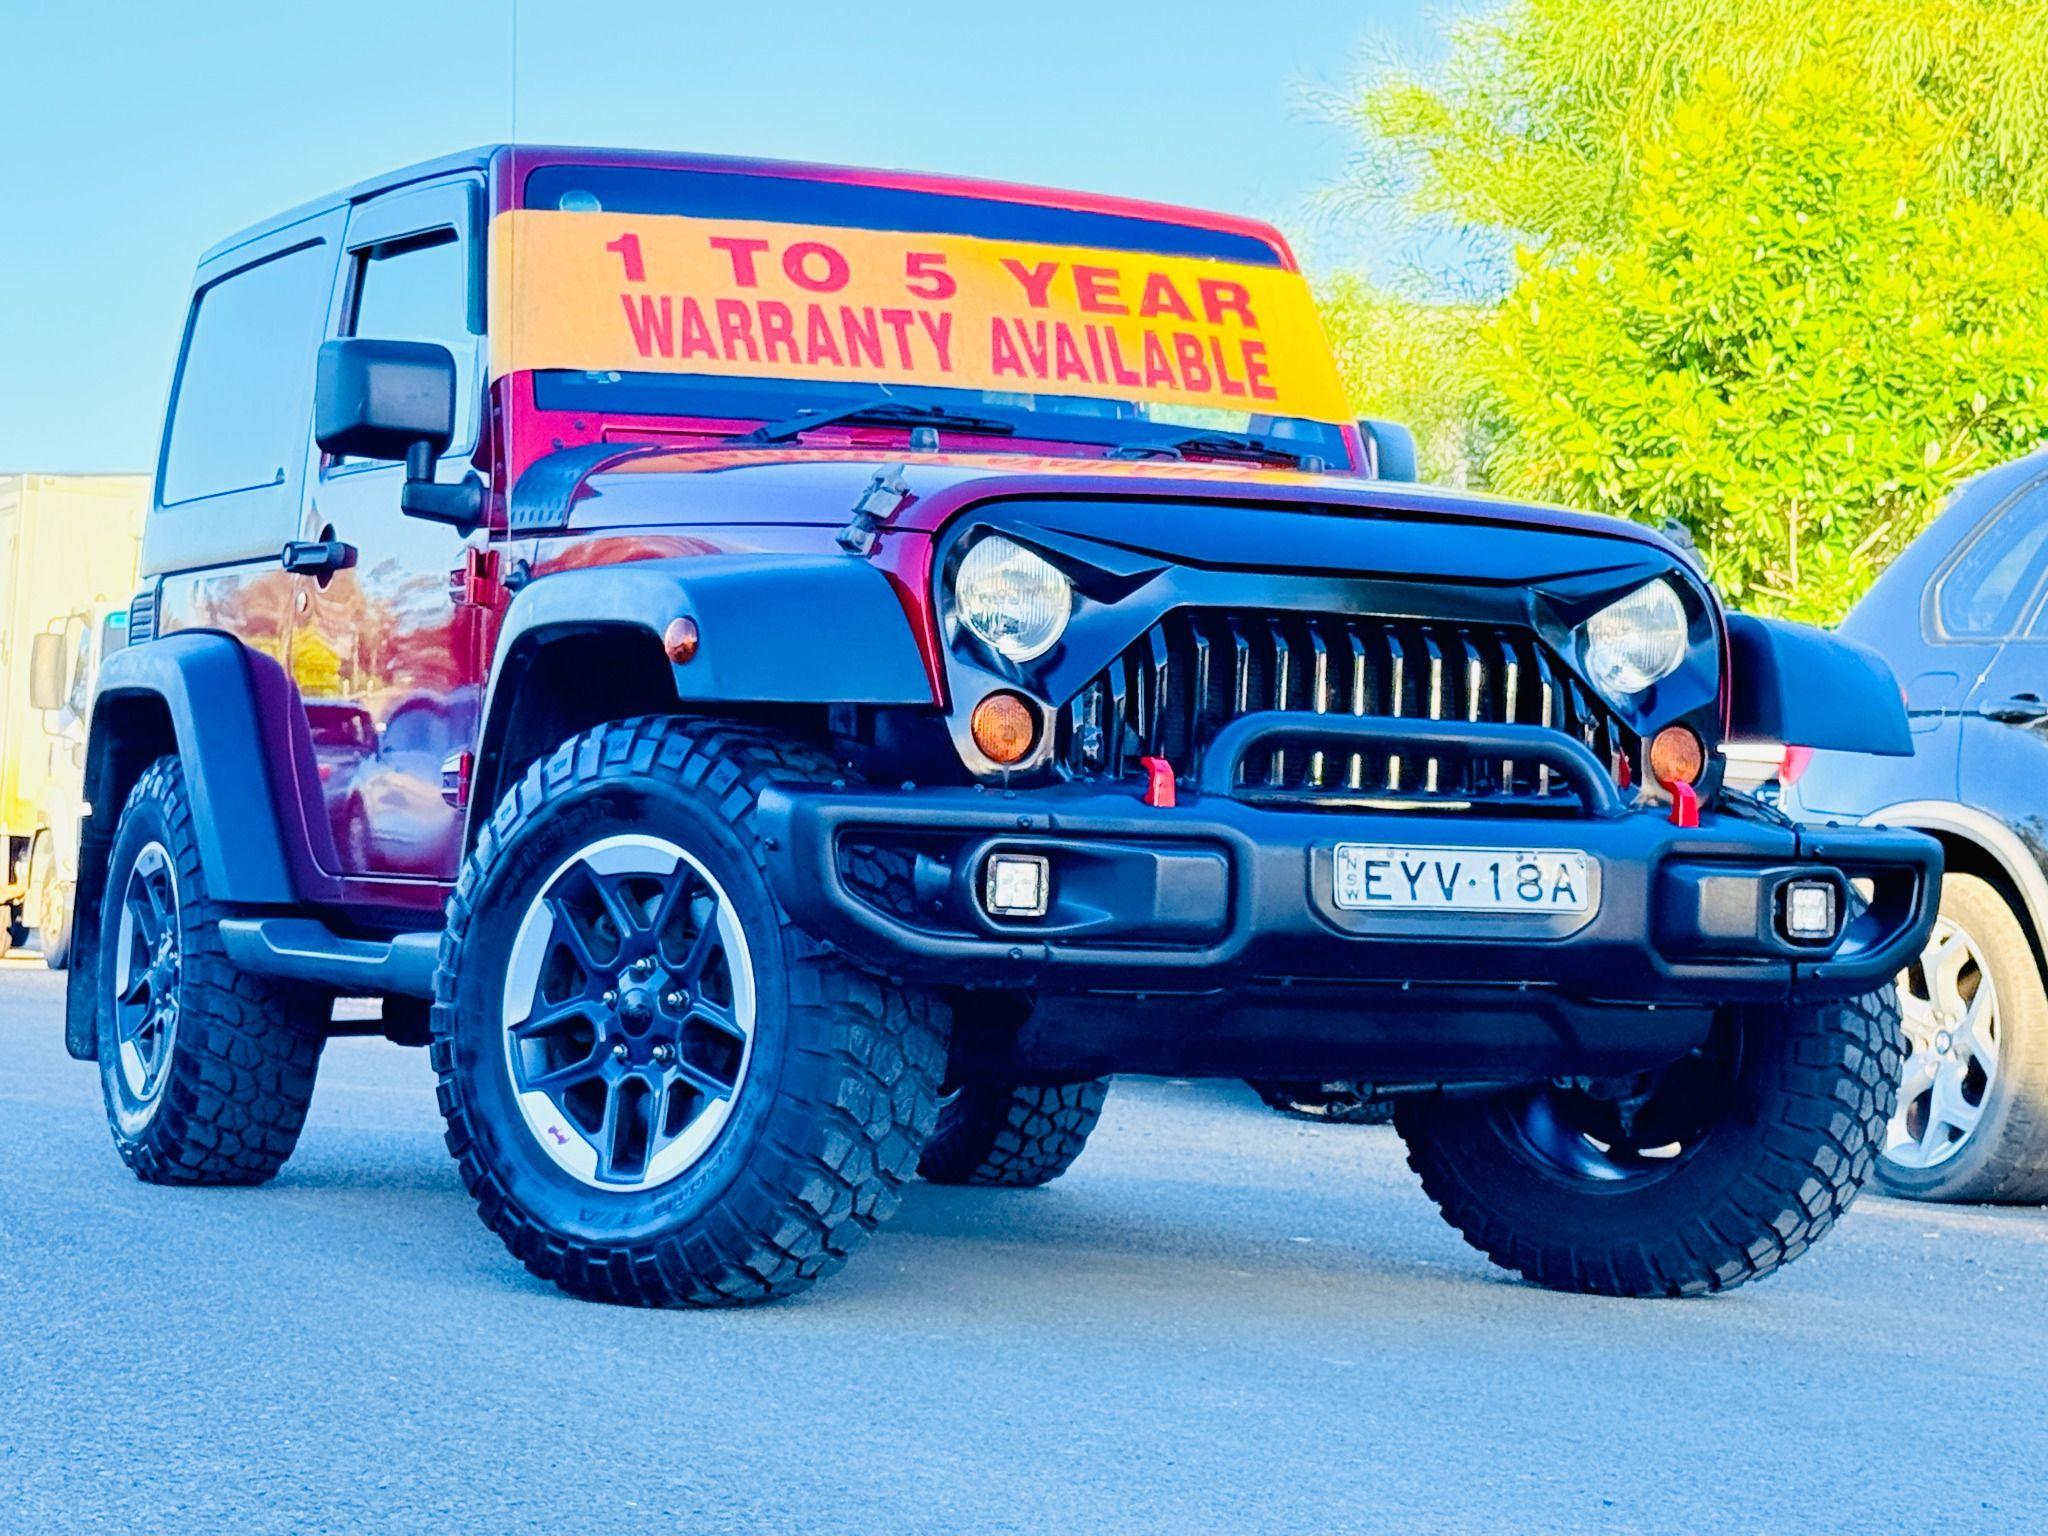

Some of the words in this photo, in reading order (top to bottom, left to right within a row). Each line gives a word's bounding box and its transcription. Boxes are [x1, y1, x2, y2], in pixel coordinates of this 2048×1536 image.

[606, 233, 645, 282] 1
[709, 236, 850, 293] TO
[906, 252, 957, 300] 5
[1001, 259, 1258, 328] YEAR
[621, 294, 953, 372] WARRANTY
[991, 316, 1277, 400] AVAILABLE
